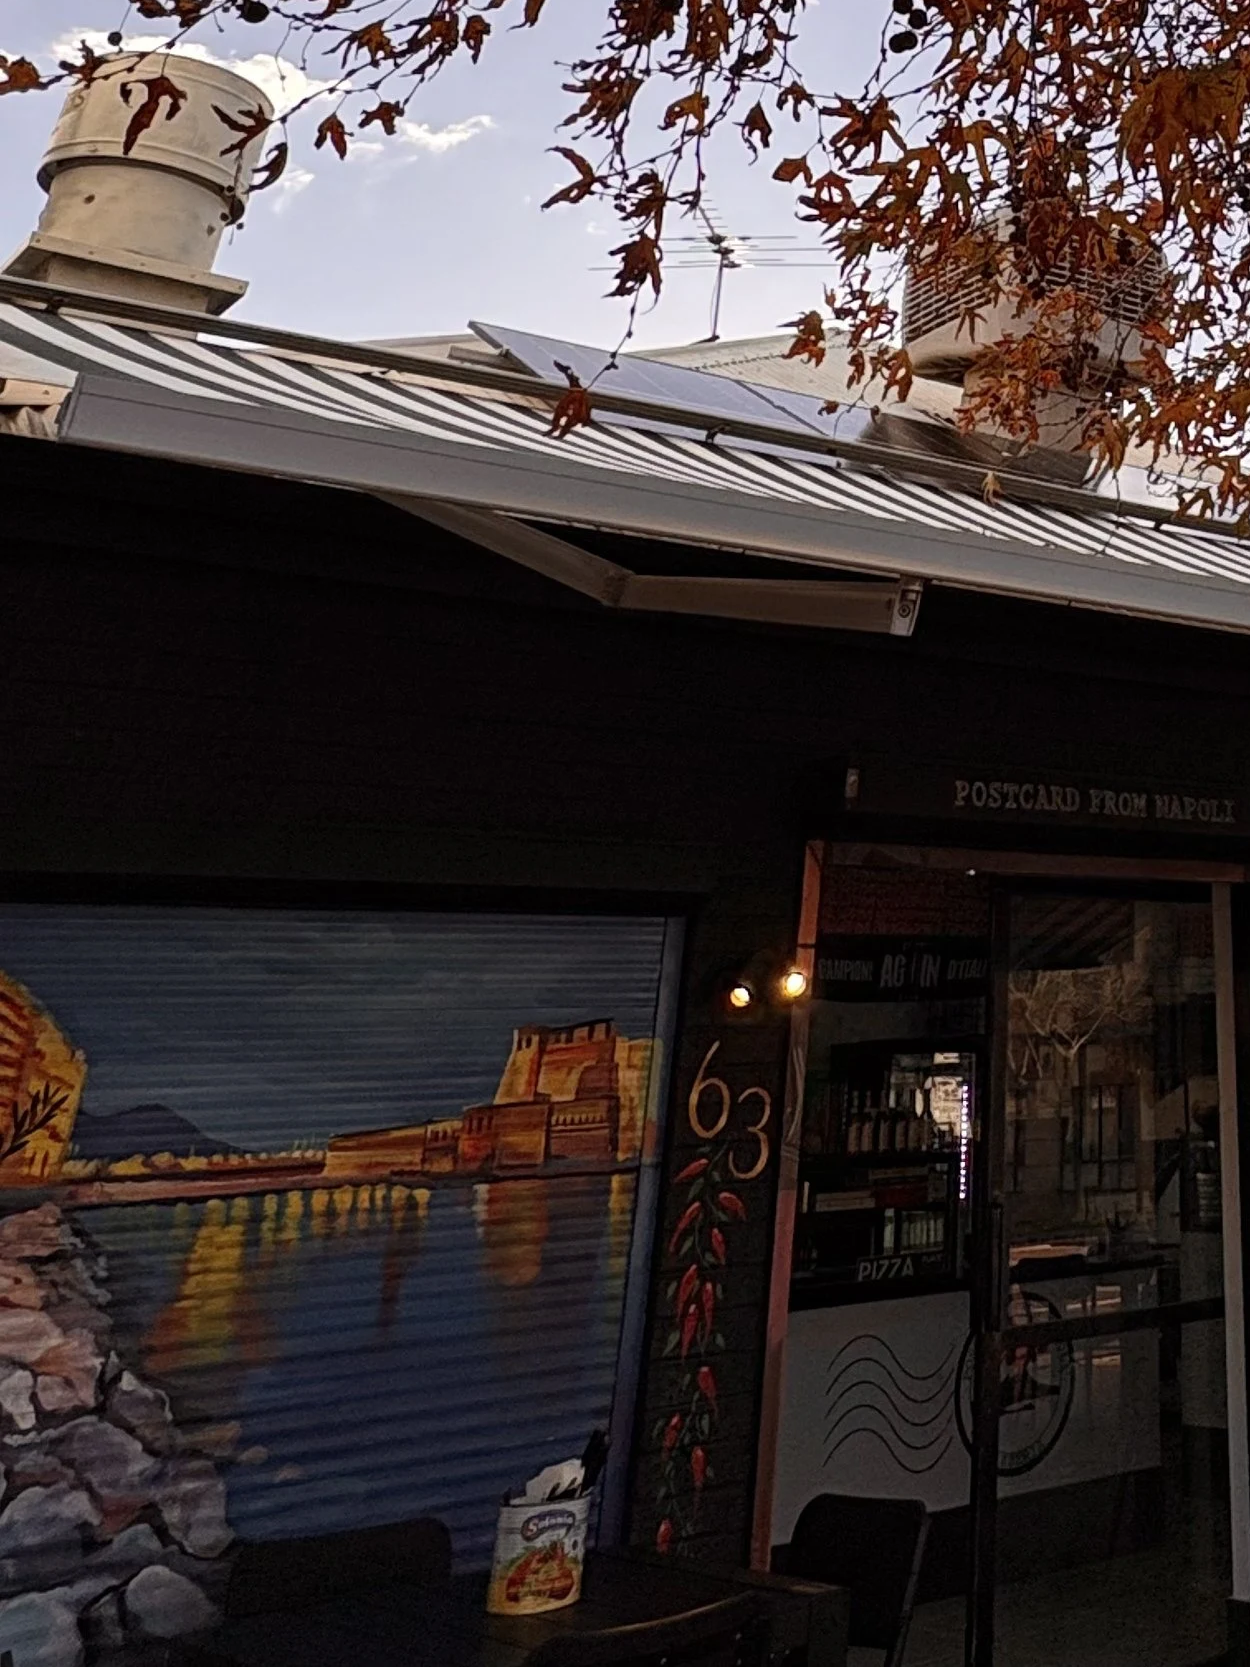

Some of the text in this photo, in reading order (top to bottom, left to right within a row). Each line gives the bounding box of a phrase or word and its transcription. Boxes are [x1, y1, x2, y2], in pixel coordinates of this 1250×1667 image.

[954, 778, 1237, 824] POSTCARD FROM NAPOLI
[688, 1039, 772, 1180] 63
[857, 1254, 915, 1282] PIZZA
